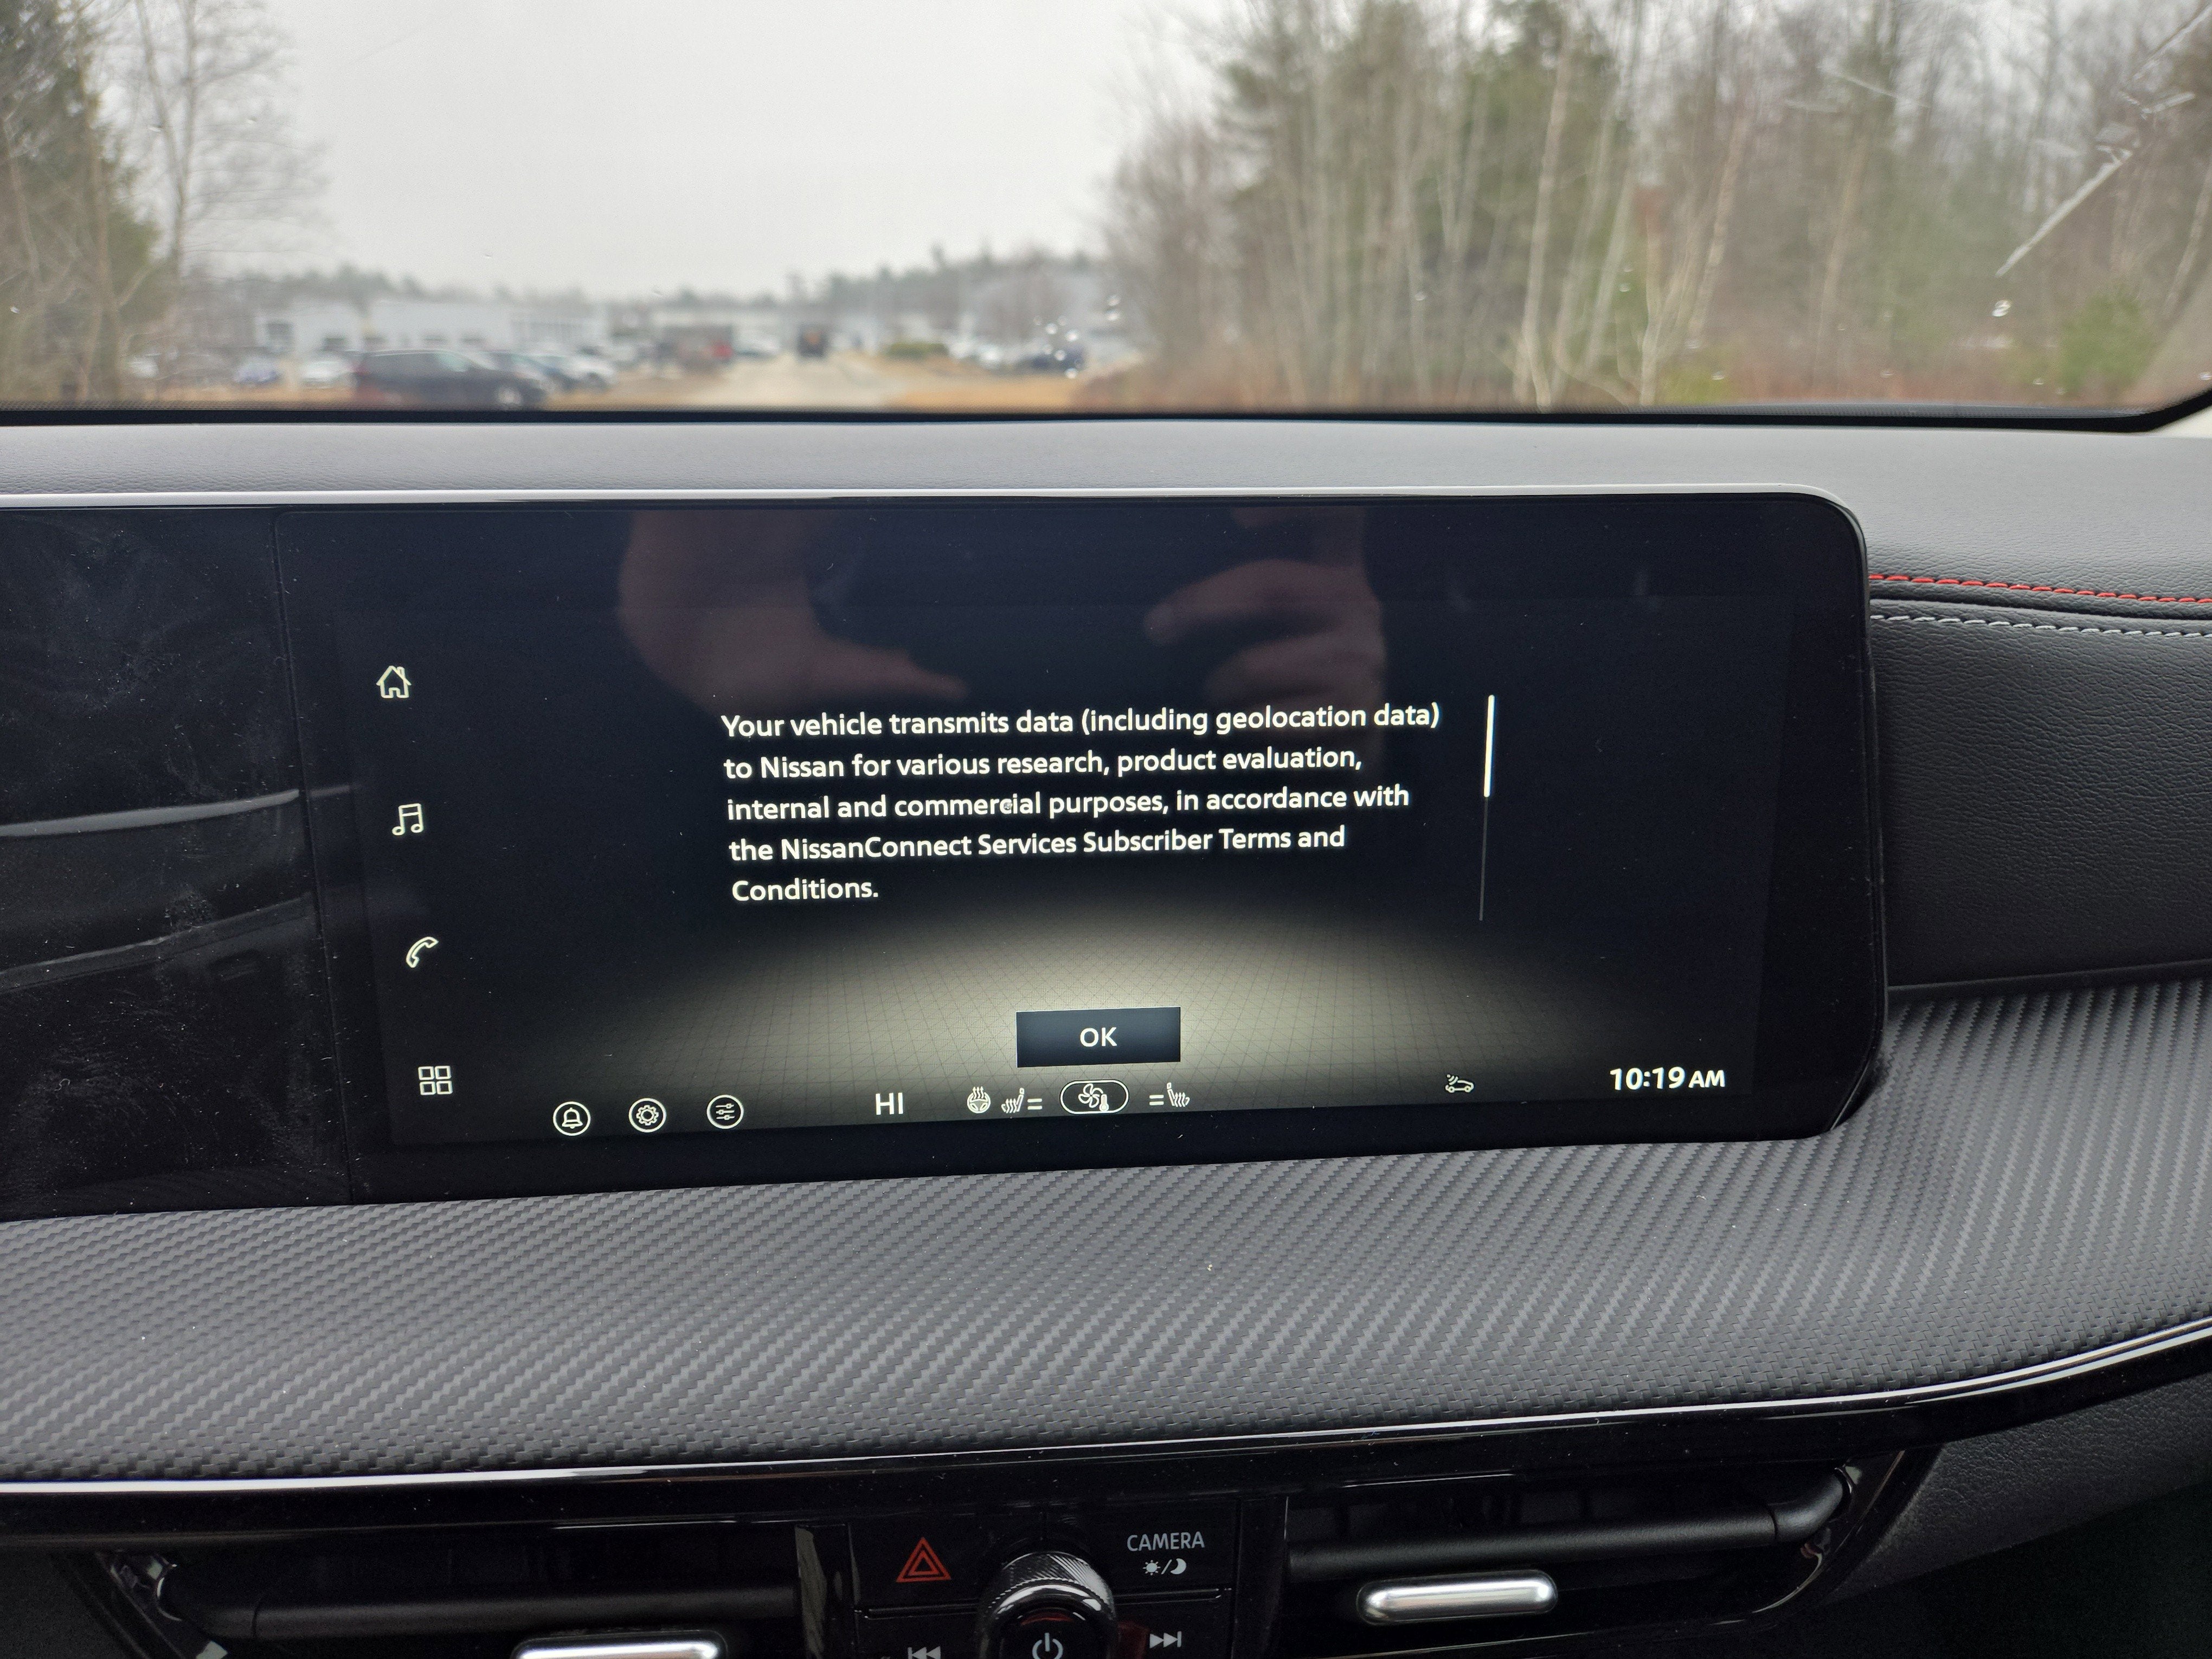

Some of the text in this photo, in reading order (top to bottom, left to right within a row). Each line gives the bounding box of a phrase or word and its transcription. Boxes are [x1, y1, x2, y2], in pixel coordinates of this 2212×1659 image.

[721, 702, 1439, 737] Your vehicle transmits data (including geolocation data)
[723, 745, 1362, 779] to Nissan for various research, product evaluation,
[728, 783, 1409, 820] internal and commercial purposes, in accordance with
[728, 824, 1345, 861] the NissanConnect Services Subscriber Terms and
[732, 877, 879, 902] Conditions.
[1079, 1026, 1117, 1047] OK
[1610, 1066, 1726, 1091] 10:19 AM
[875, 1092, 904, 1115] HI
[1127, 1531, 1204, 1551] CAMERA
